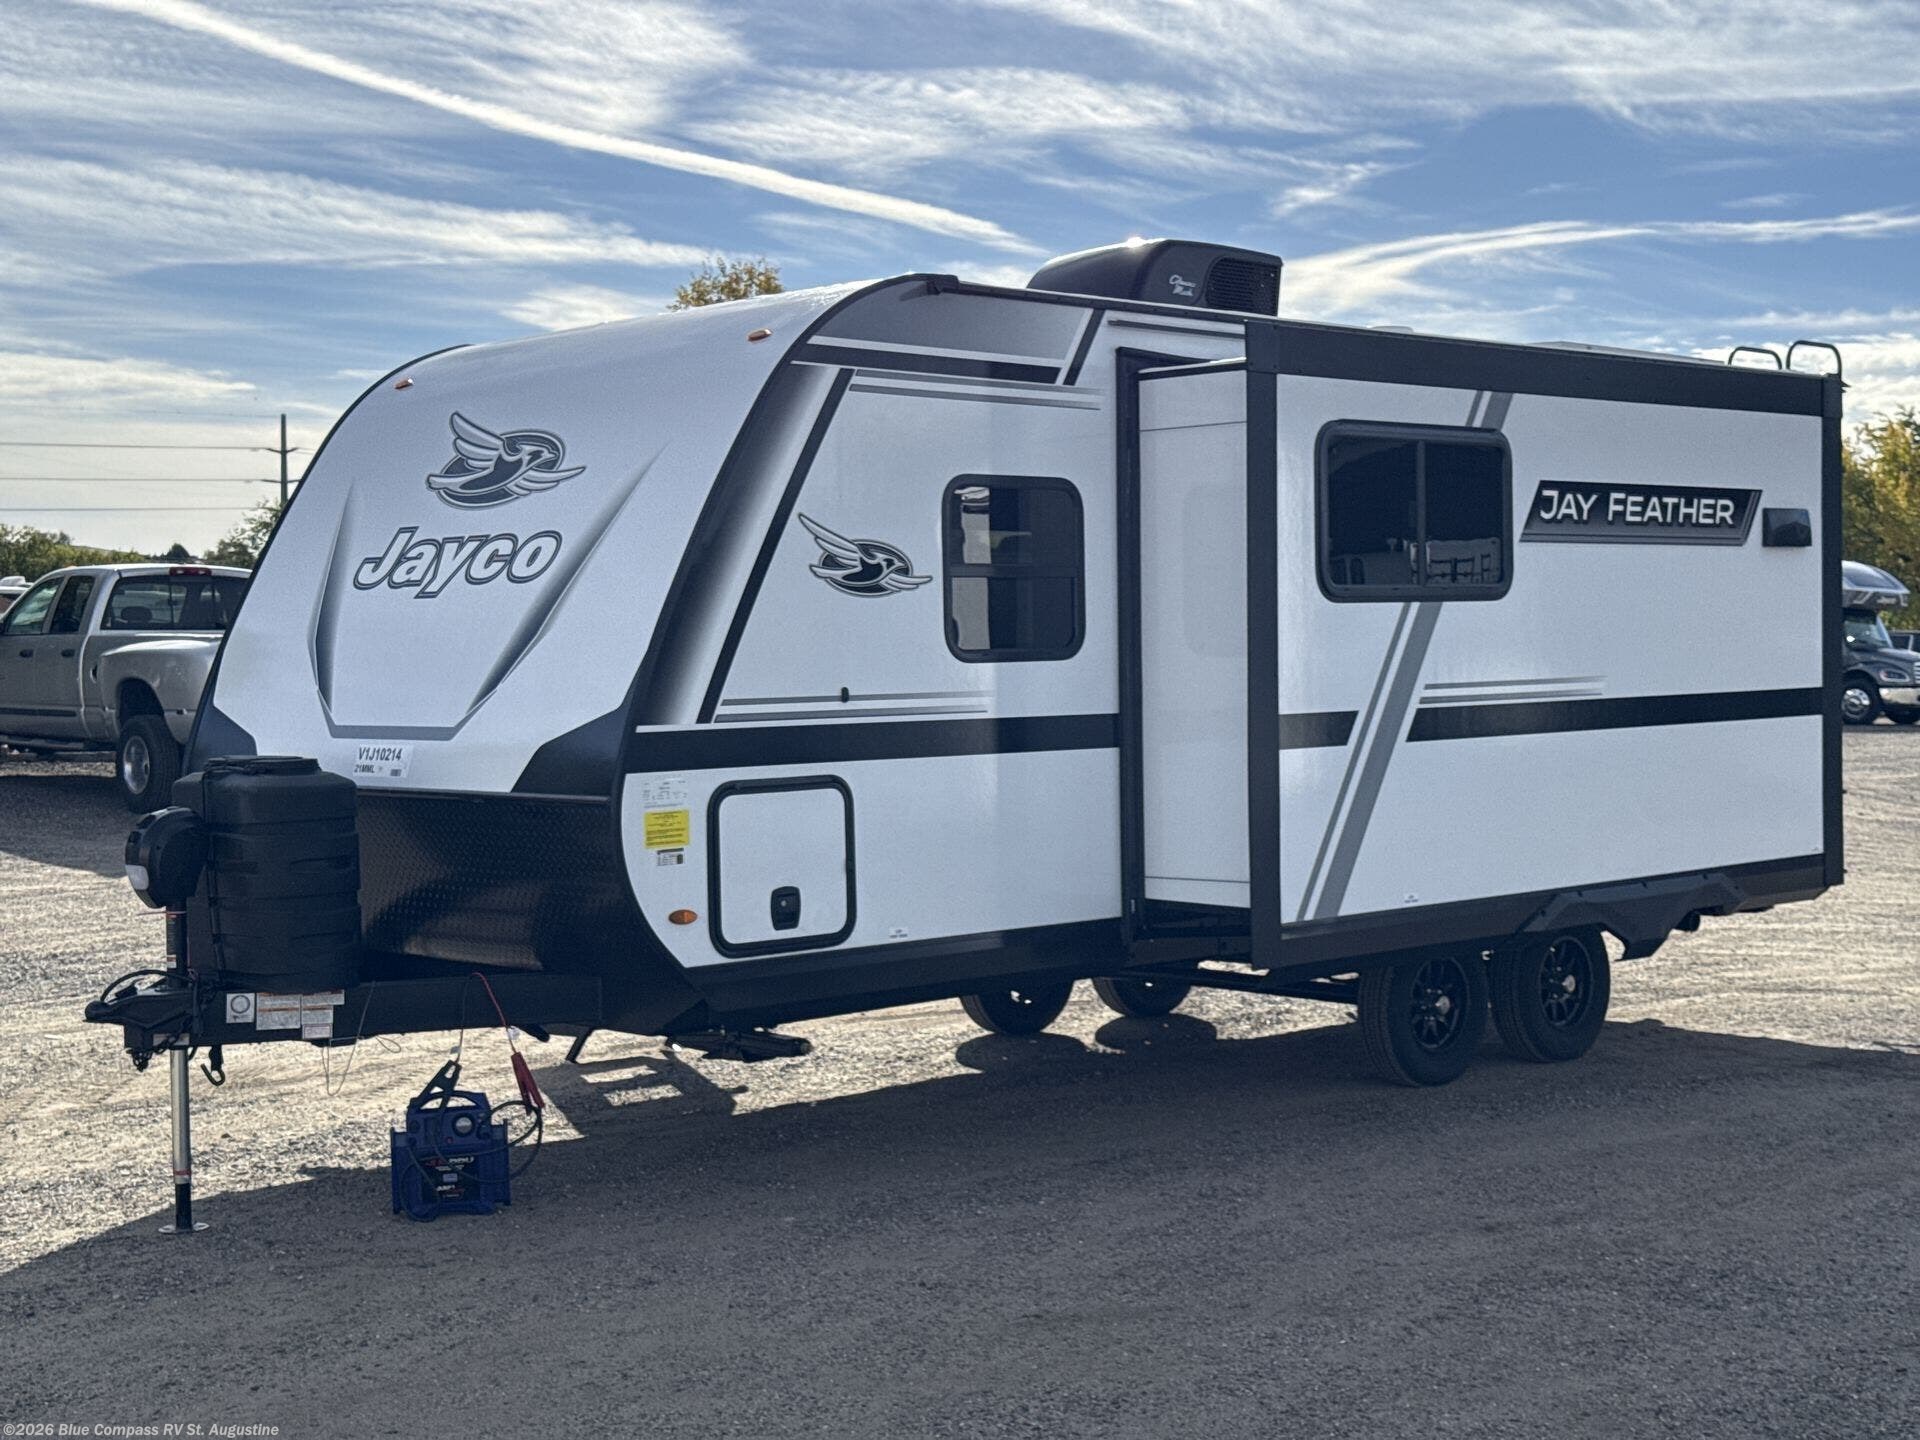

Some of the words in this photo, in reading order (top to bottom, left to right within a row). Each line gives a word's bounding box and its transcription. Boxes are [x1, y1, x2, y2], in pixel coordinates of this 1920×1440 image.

[1540, 489, 1598, 520] JAY
[1608, 492, 1735, 525] FEATHER
[353, 526, 562, 599] Jayco
[359, 747, 402, 761] V1J10214
